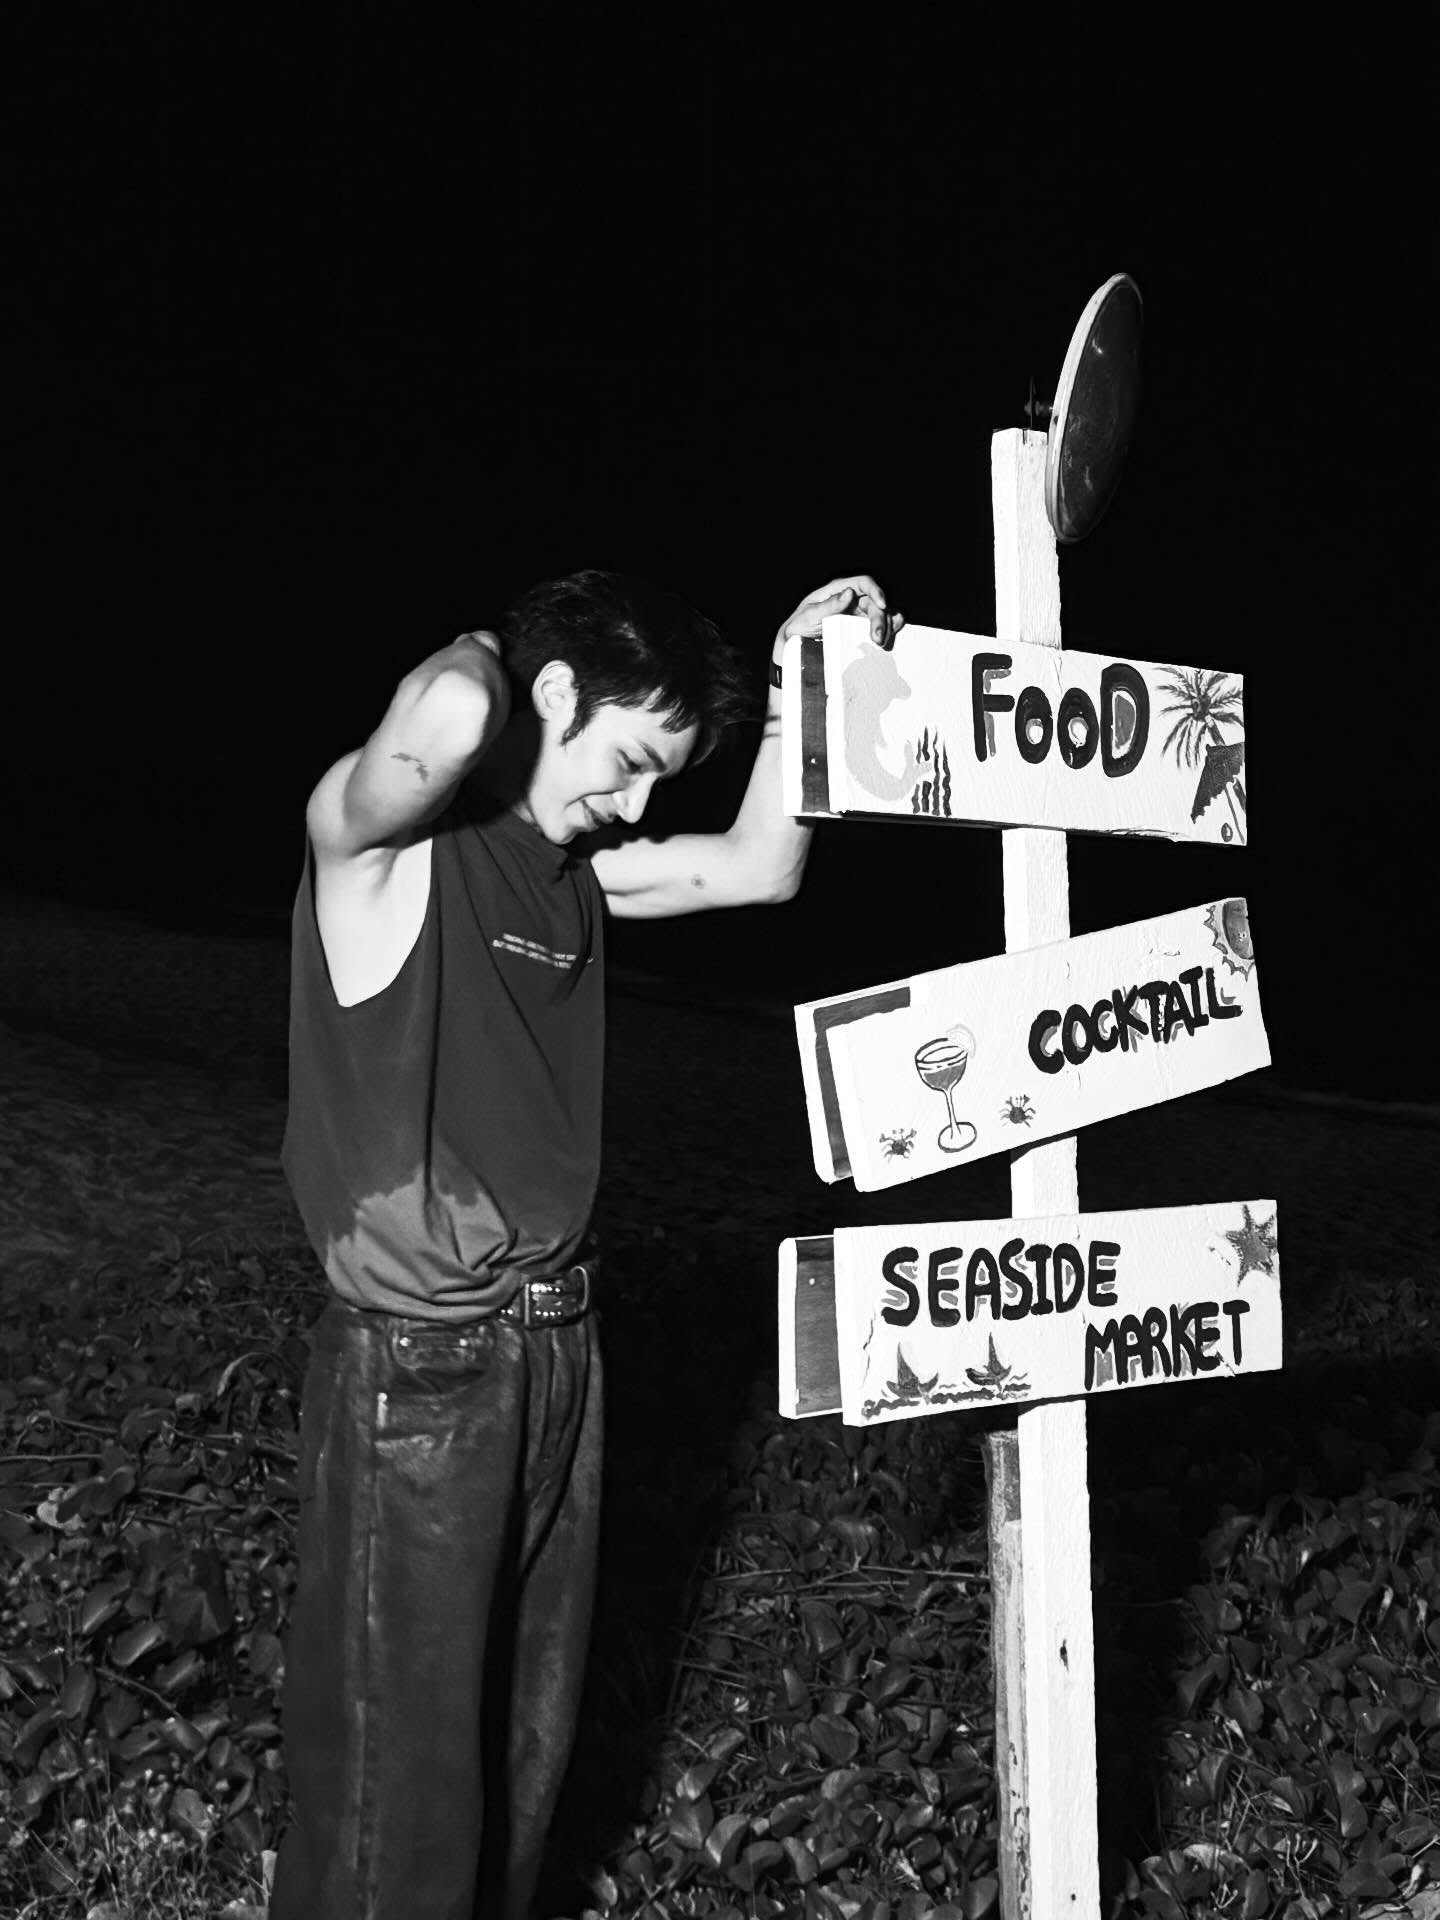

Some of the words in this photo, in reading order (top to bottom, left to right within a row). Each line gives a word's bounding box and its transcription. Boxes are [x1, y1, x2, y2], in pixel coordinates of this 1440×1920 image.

[1028, 966, 1243, 1074] COCKTAIL
[881, 1238, 1121, 1328] SEASIDE
[1084, 1299, 1250, 1391] MARKET
